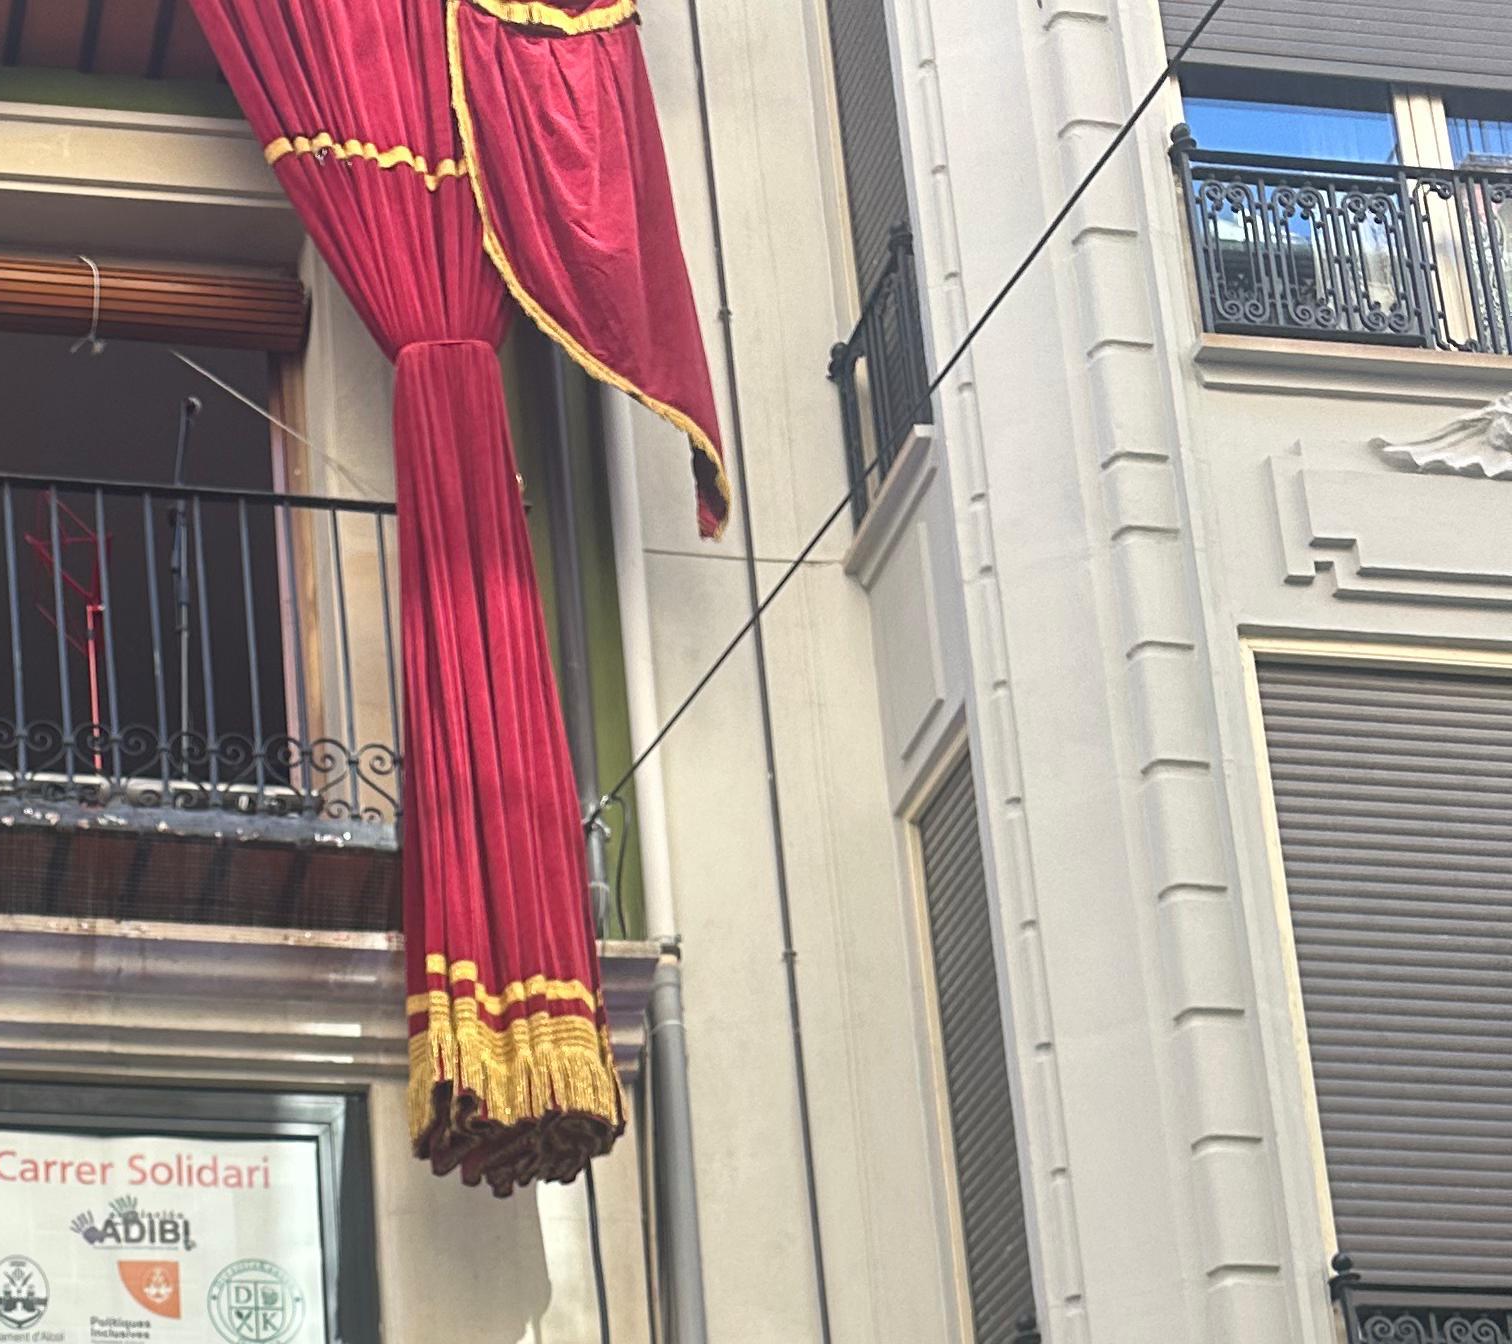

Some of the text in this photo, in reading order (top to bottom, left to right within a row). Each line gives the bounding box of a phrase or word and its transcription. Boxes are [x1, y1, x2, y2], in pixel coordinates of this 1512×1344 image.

[128, 1153, 271, 1189] Solidari
[235, 1286, 252, 1304] D
[263, 1312, 278, 1331] K
